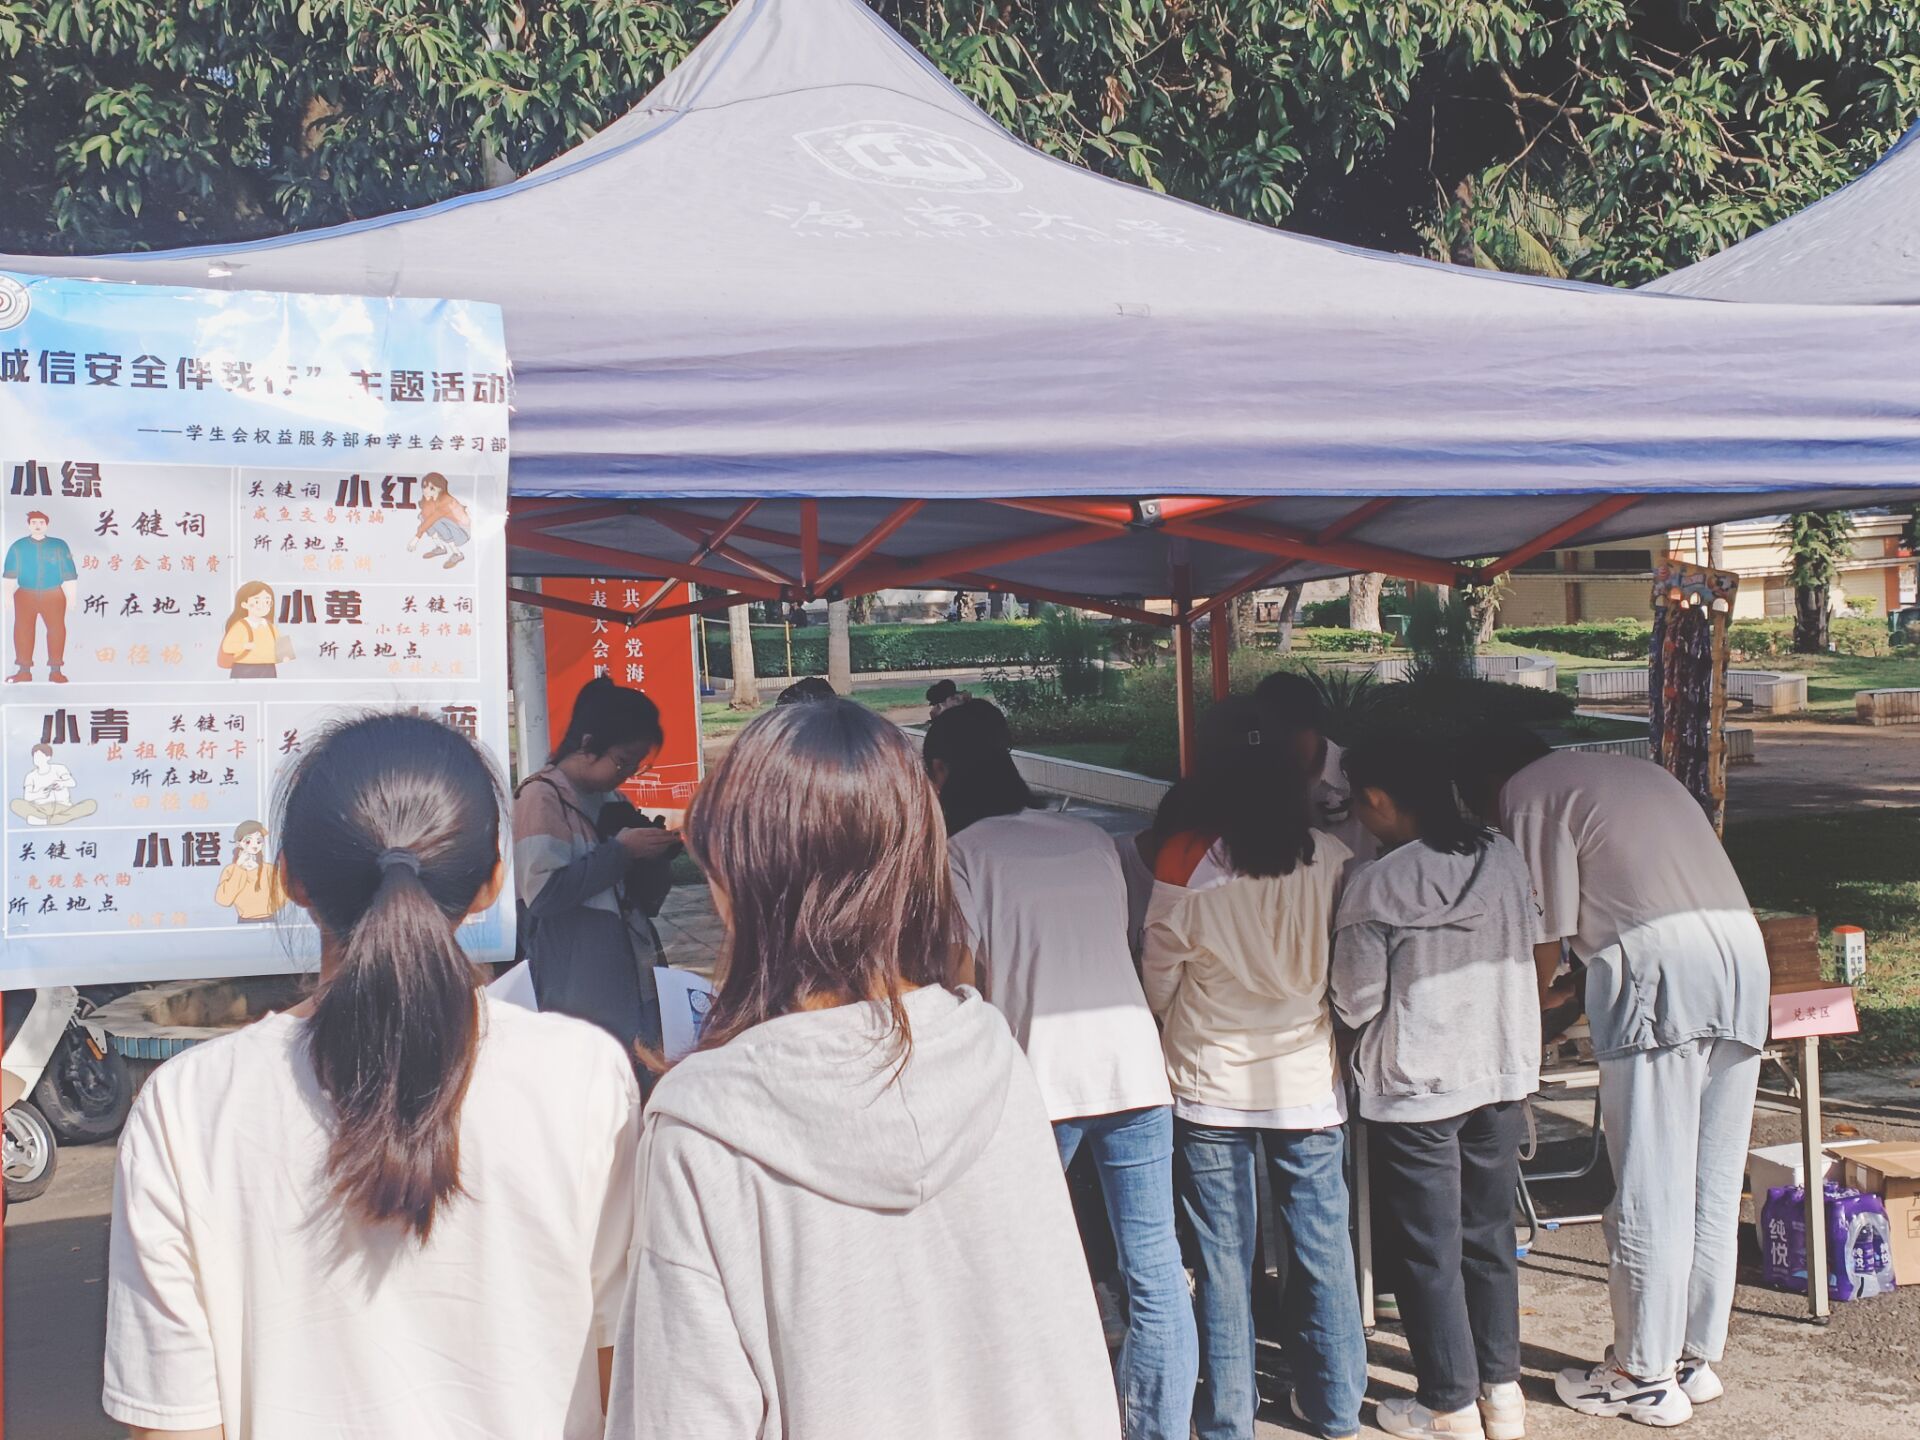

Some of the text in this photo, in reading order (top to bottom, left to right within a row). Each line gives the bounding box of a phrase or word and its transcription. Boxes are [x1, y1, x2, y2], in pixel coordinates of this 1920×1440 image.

[10, 460, 102, 498] 小绿
[248, 480, 321, 499] 关键词
[335, 474, 418, 509] 小红
[94, 509, 208, 538] 关键词
[253, 533, 349, 552] 所在地点
[83, 593, 212, 618] 所在地点
[278, 589, 363, 624] 小黄
[401, 596, 473, 614] 关键词
[319, 639, 422, 661] 所在地点
[41, 708, 129, 744] 小青
[169, 713, 245, 733] 关键词
[131, 766, 240, 787] 所在地点
[19, 841, 98, 861] 关键词
[133, 832, 221, 867] 小橙
[8, 893, 118, 915] 所在地点
[1769, 1218, 1789, 1268] 纯悦
